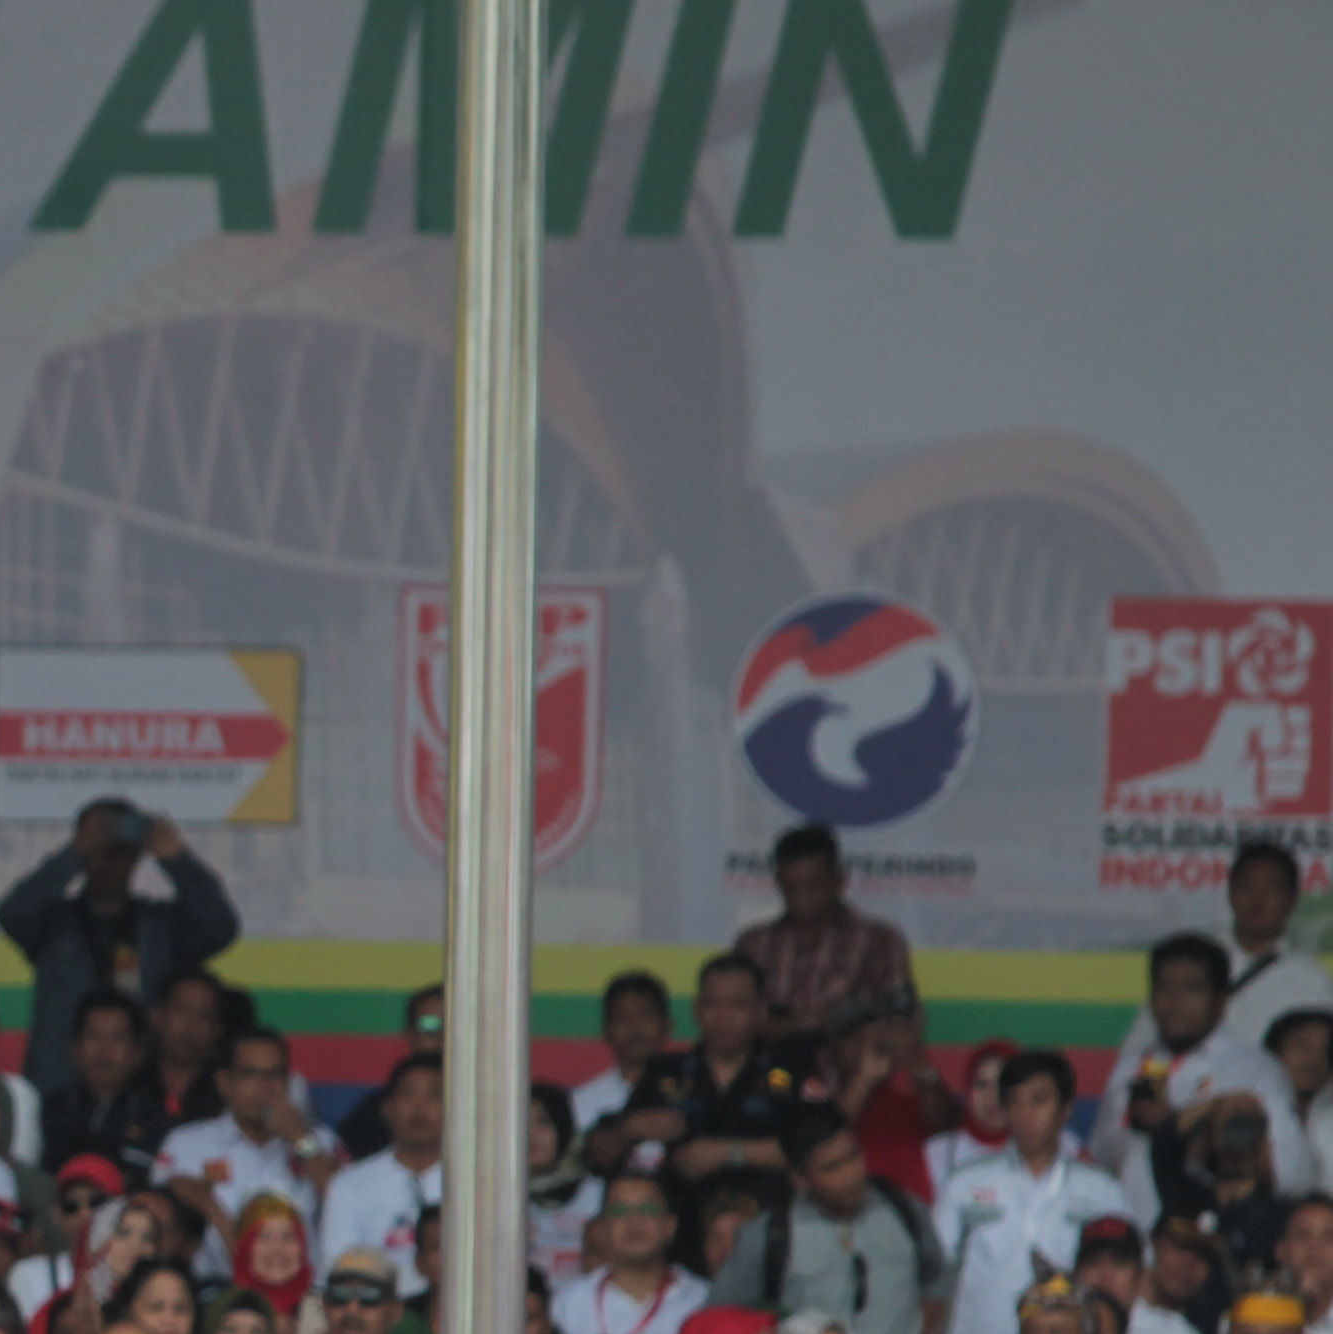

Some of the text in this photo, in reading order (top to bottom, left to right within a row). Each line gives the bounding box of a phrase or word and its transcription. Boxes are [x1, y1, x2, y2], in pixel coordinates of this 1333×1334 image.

[25, 0, 1017, 242] AMIN
[1104, 626, 1224, 697] PSI
[22, 715, 227, 752] HANURA
